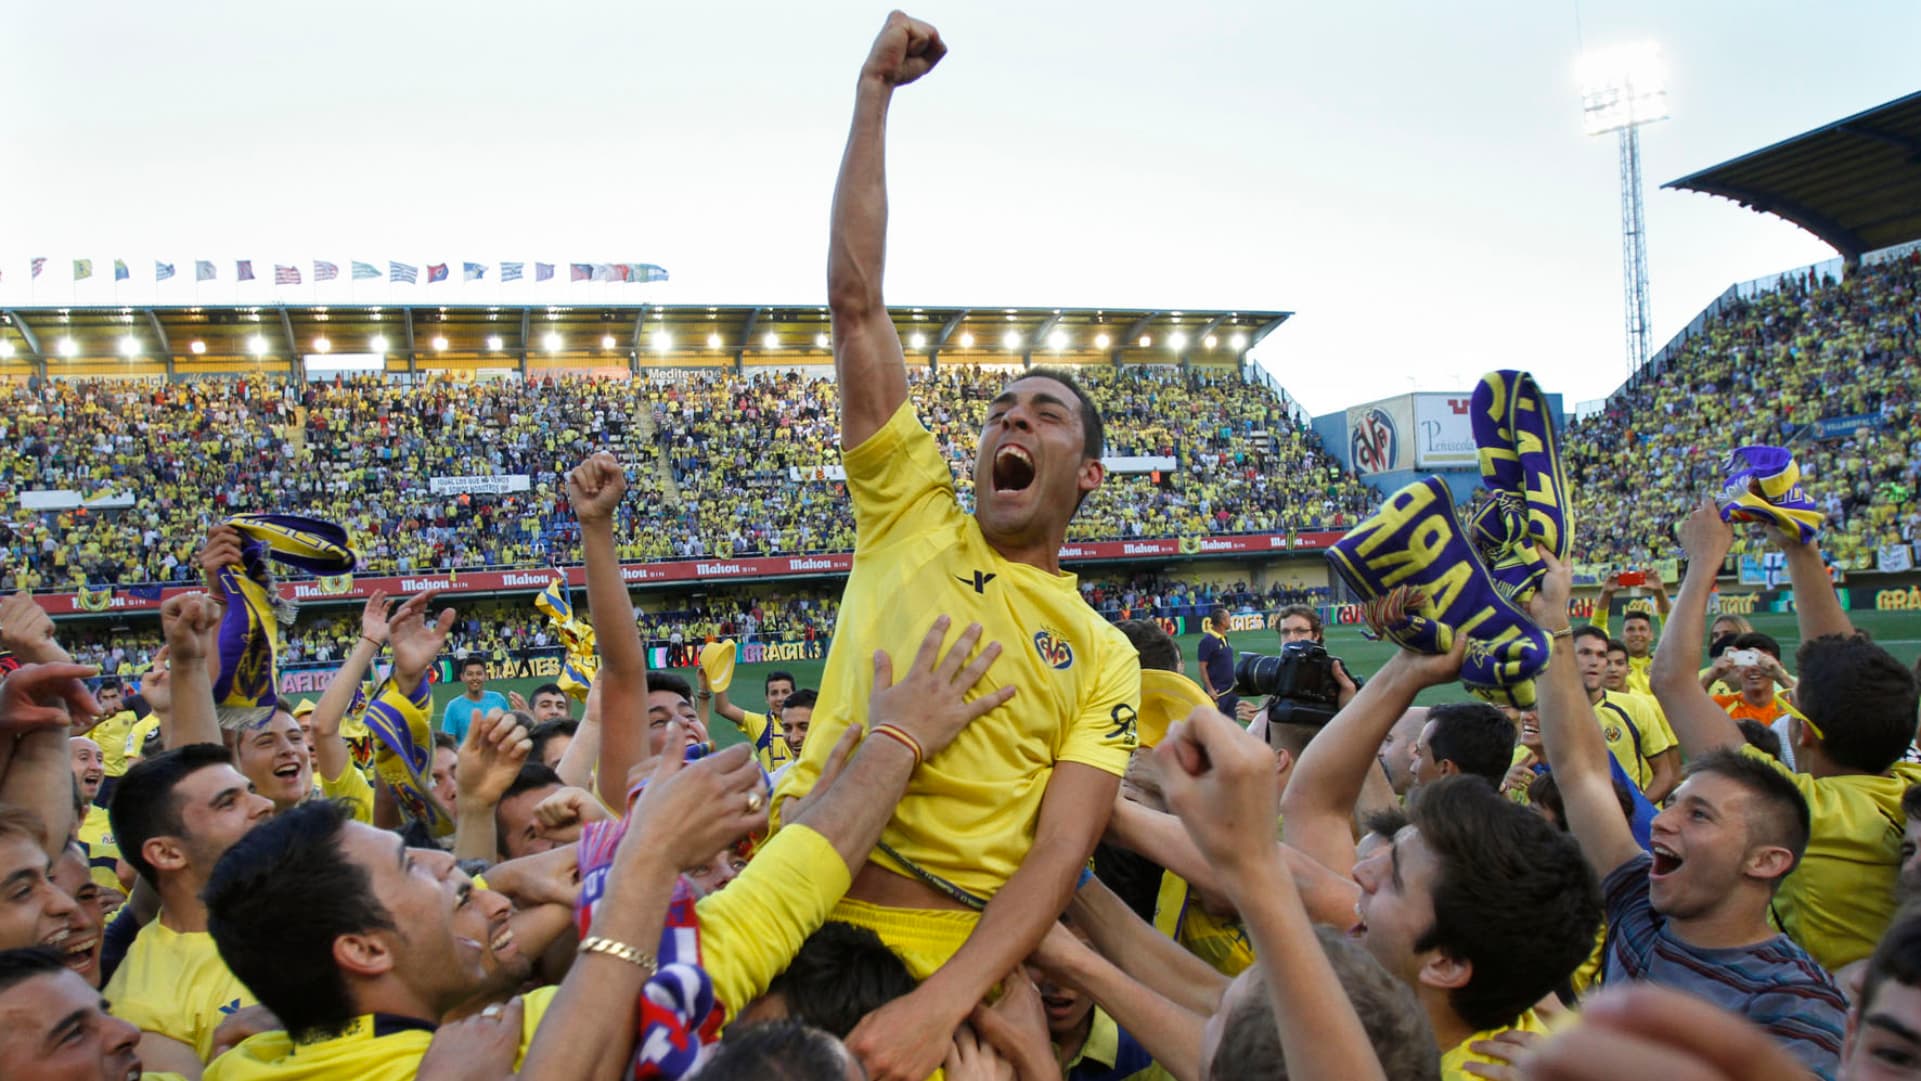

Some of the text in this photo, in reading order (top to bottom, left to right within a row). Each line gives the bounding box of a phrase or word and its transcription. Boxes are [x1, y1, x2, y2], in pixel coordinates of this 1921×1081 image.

[1058, 547, 1082, 556] ahou
[1124, 543, 1160, 554] Mahou
[696, 563, 739, 575] Mahou
[789, 558, 831, 570] Mahou
[621, 567, 648, 579] hou
[401, 578, 449, 591] Mahou
[503, 573, 549, 586] Mahou
